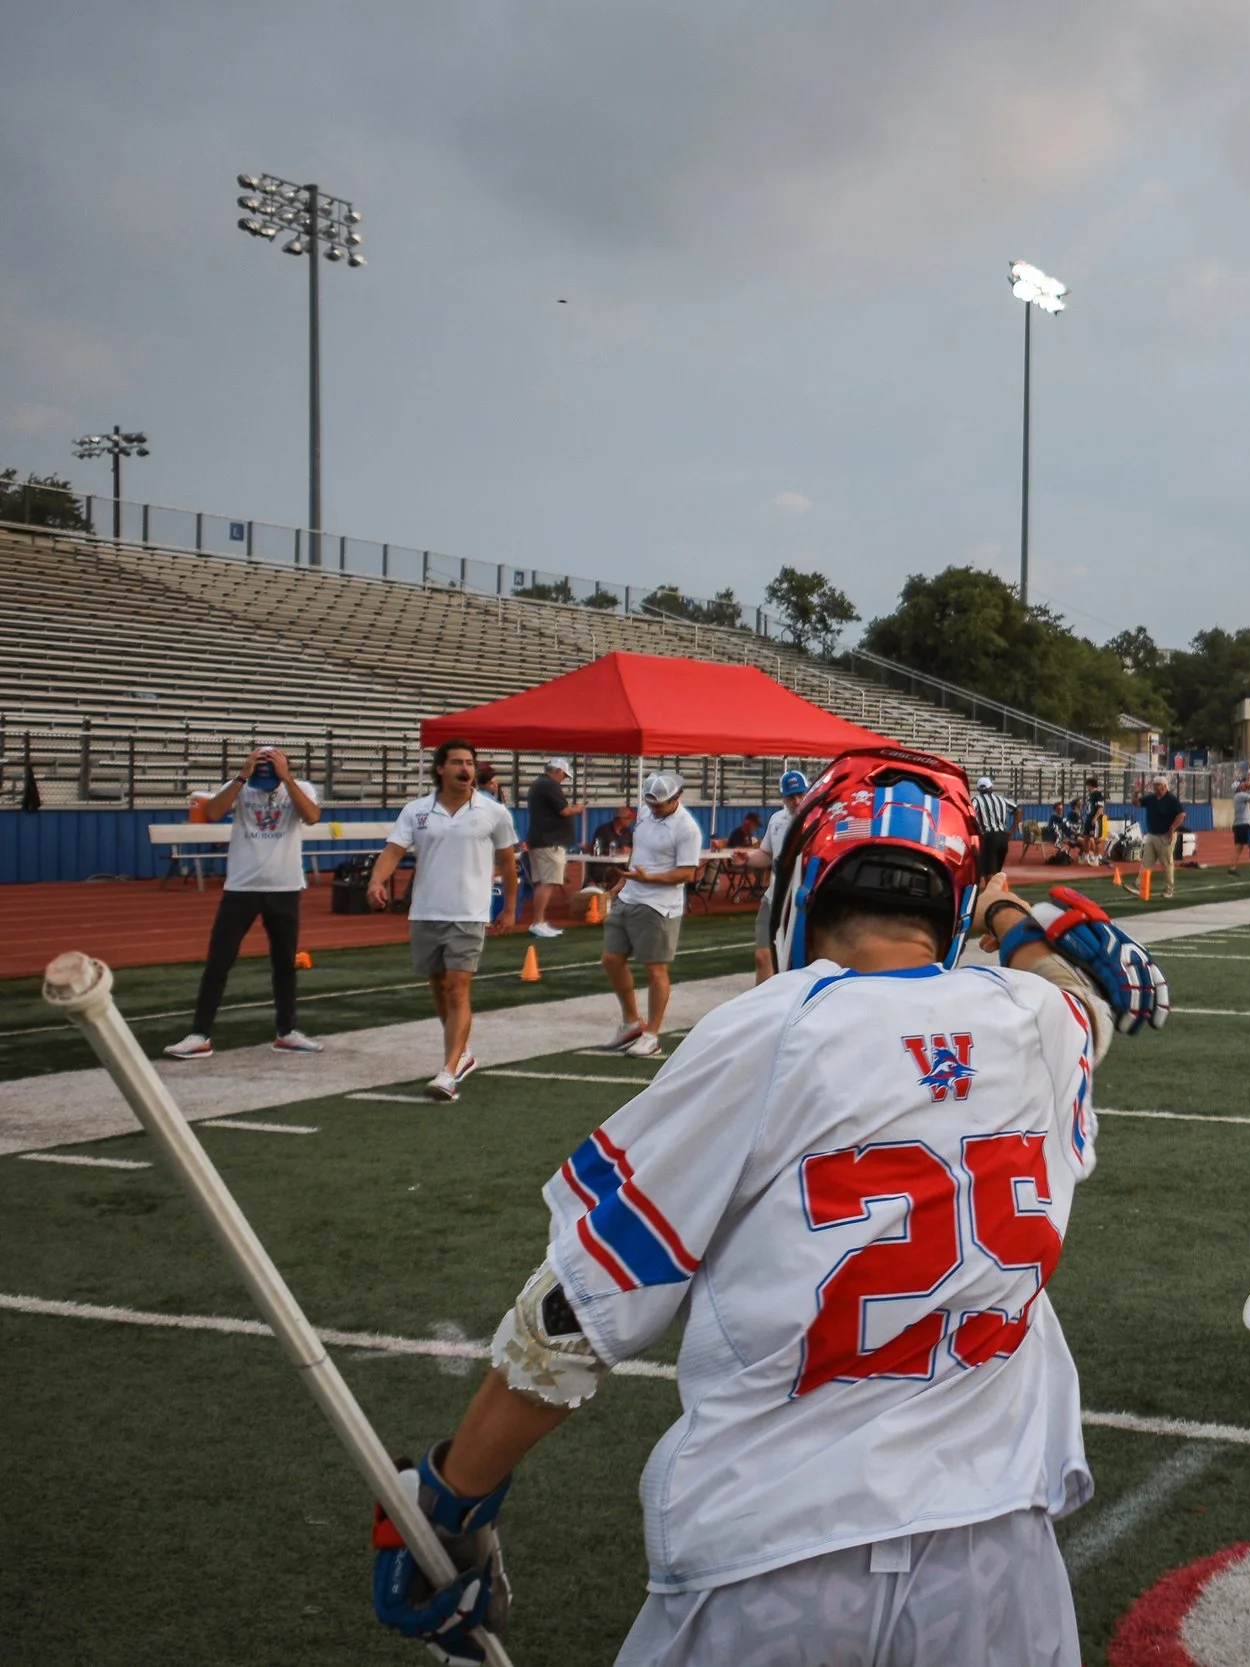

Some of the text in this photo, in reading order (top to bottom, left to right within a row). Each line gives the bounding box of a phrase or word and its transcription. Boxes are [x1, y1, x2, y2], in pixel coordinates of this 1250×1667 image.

[879, 748, 938, 766] cascade
[901, 1032, 978, 1103] W
[788, 1130, 1063, 1400] 25
